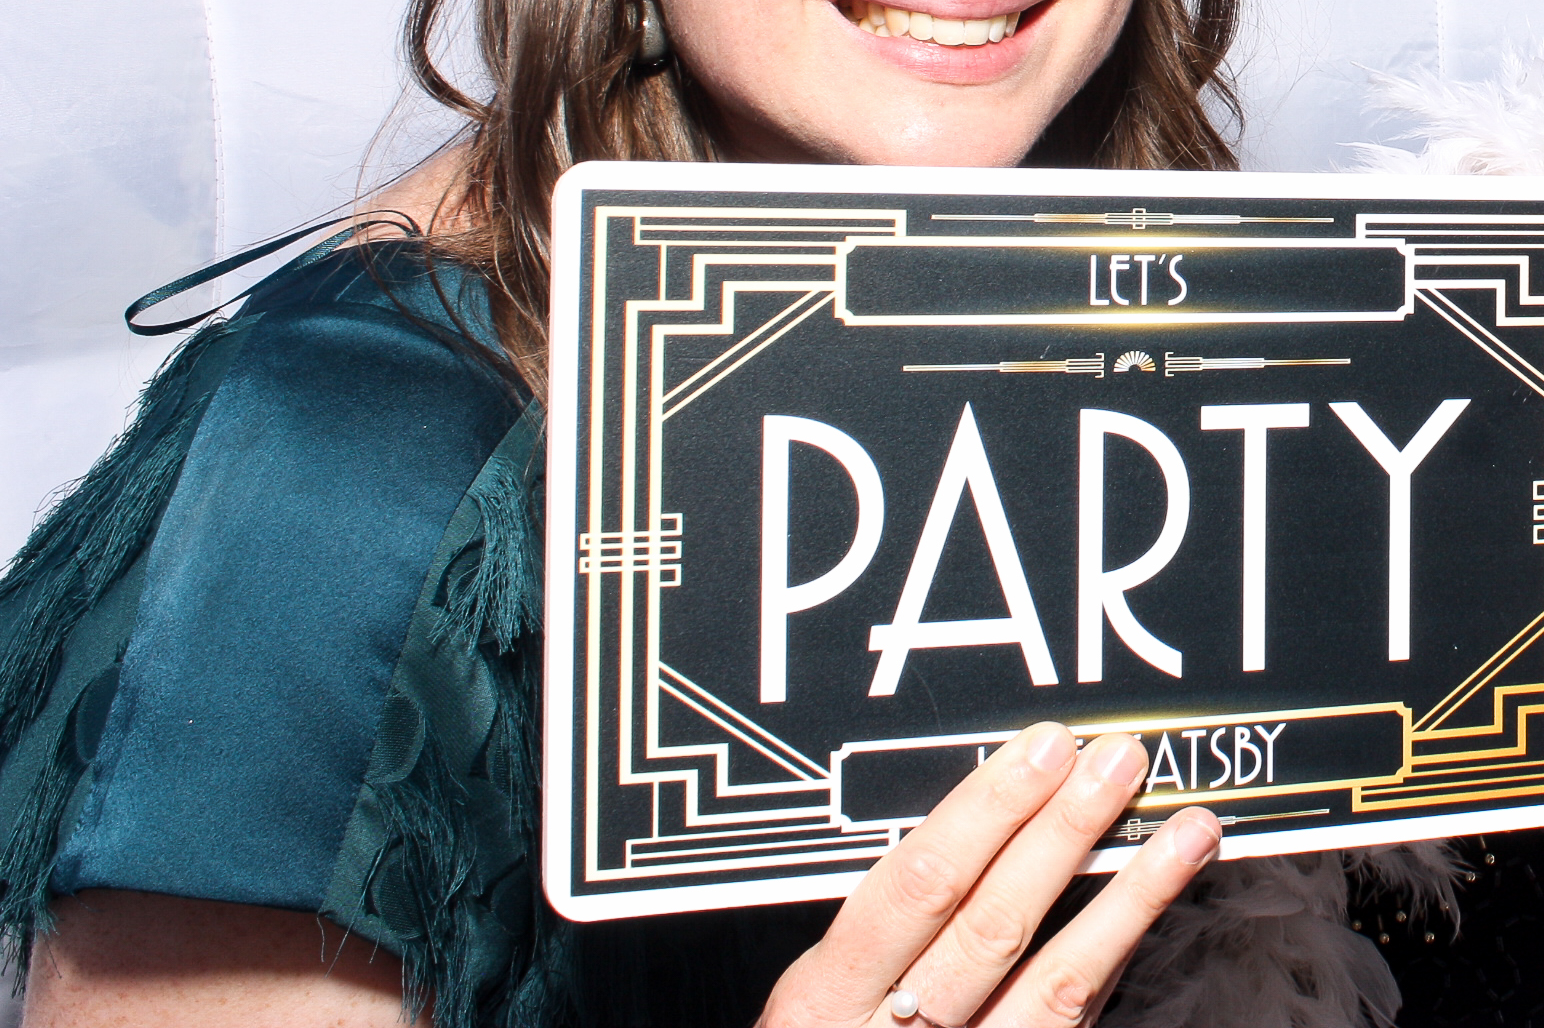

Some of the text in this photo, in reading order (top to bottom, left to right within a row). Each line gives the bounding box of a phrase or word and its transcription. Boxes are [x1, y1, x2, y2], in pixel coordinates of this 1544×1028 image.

[1089, 253, 1188, 306] LET'S
[760, 398, 1471, 703] PARTY
[1132, 722, 1287, 794] ATSBY
